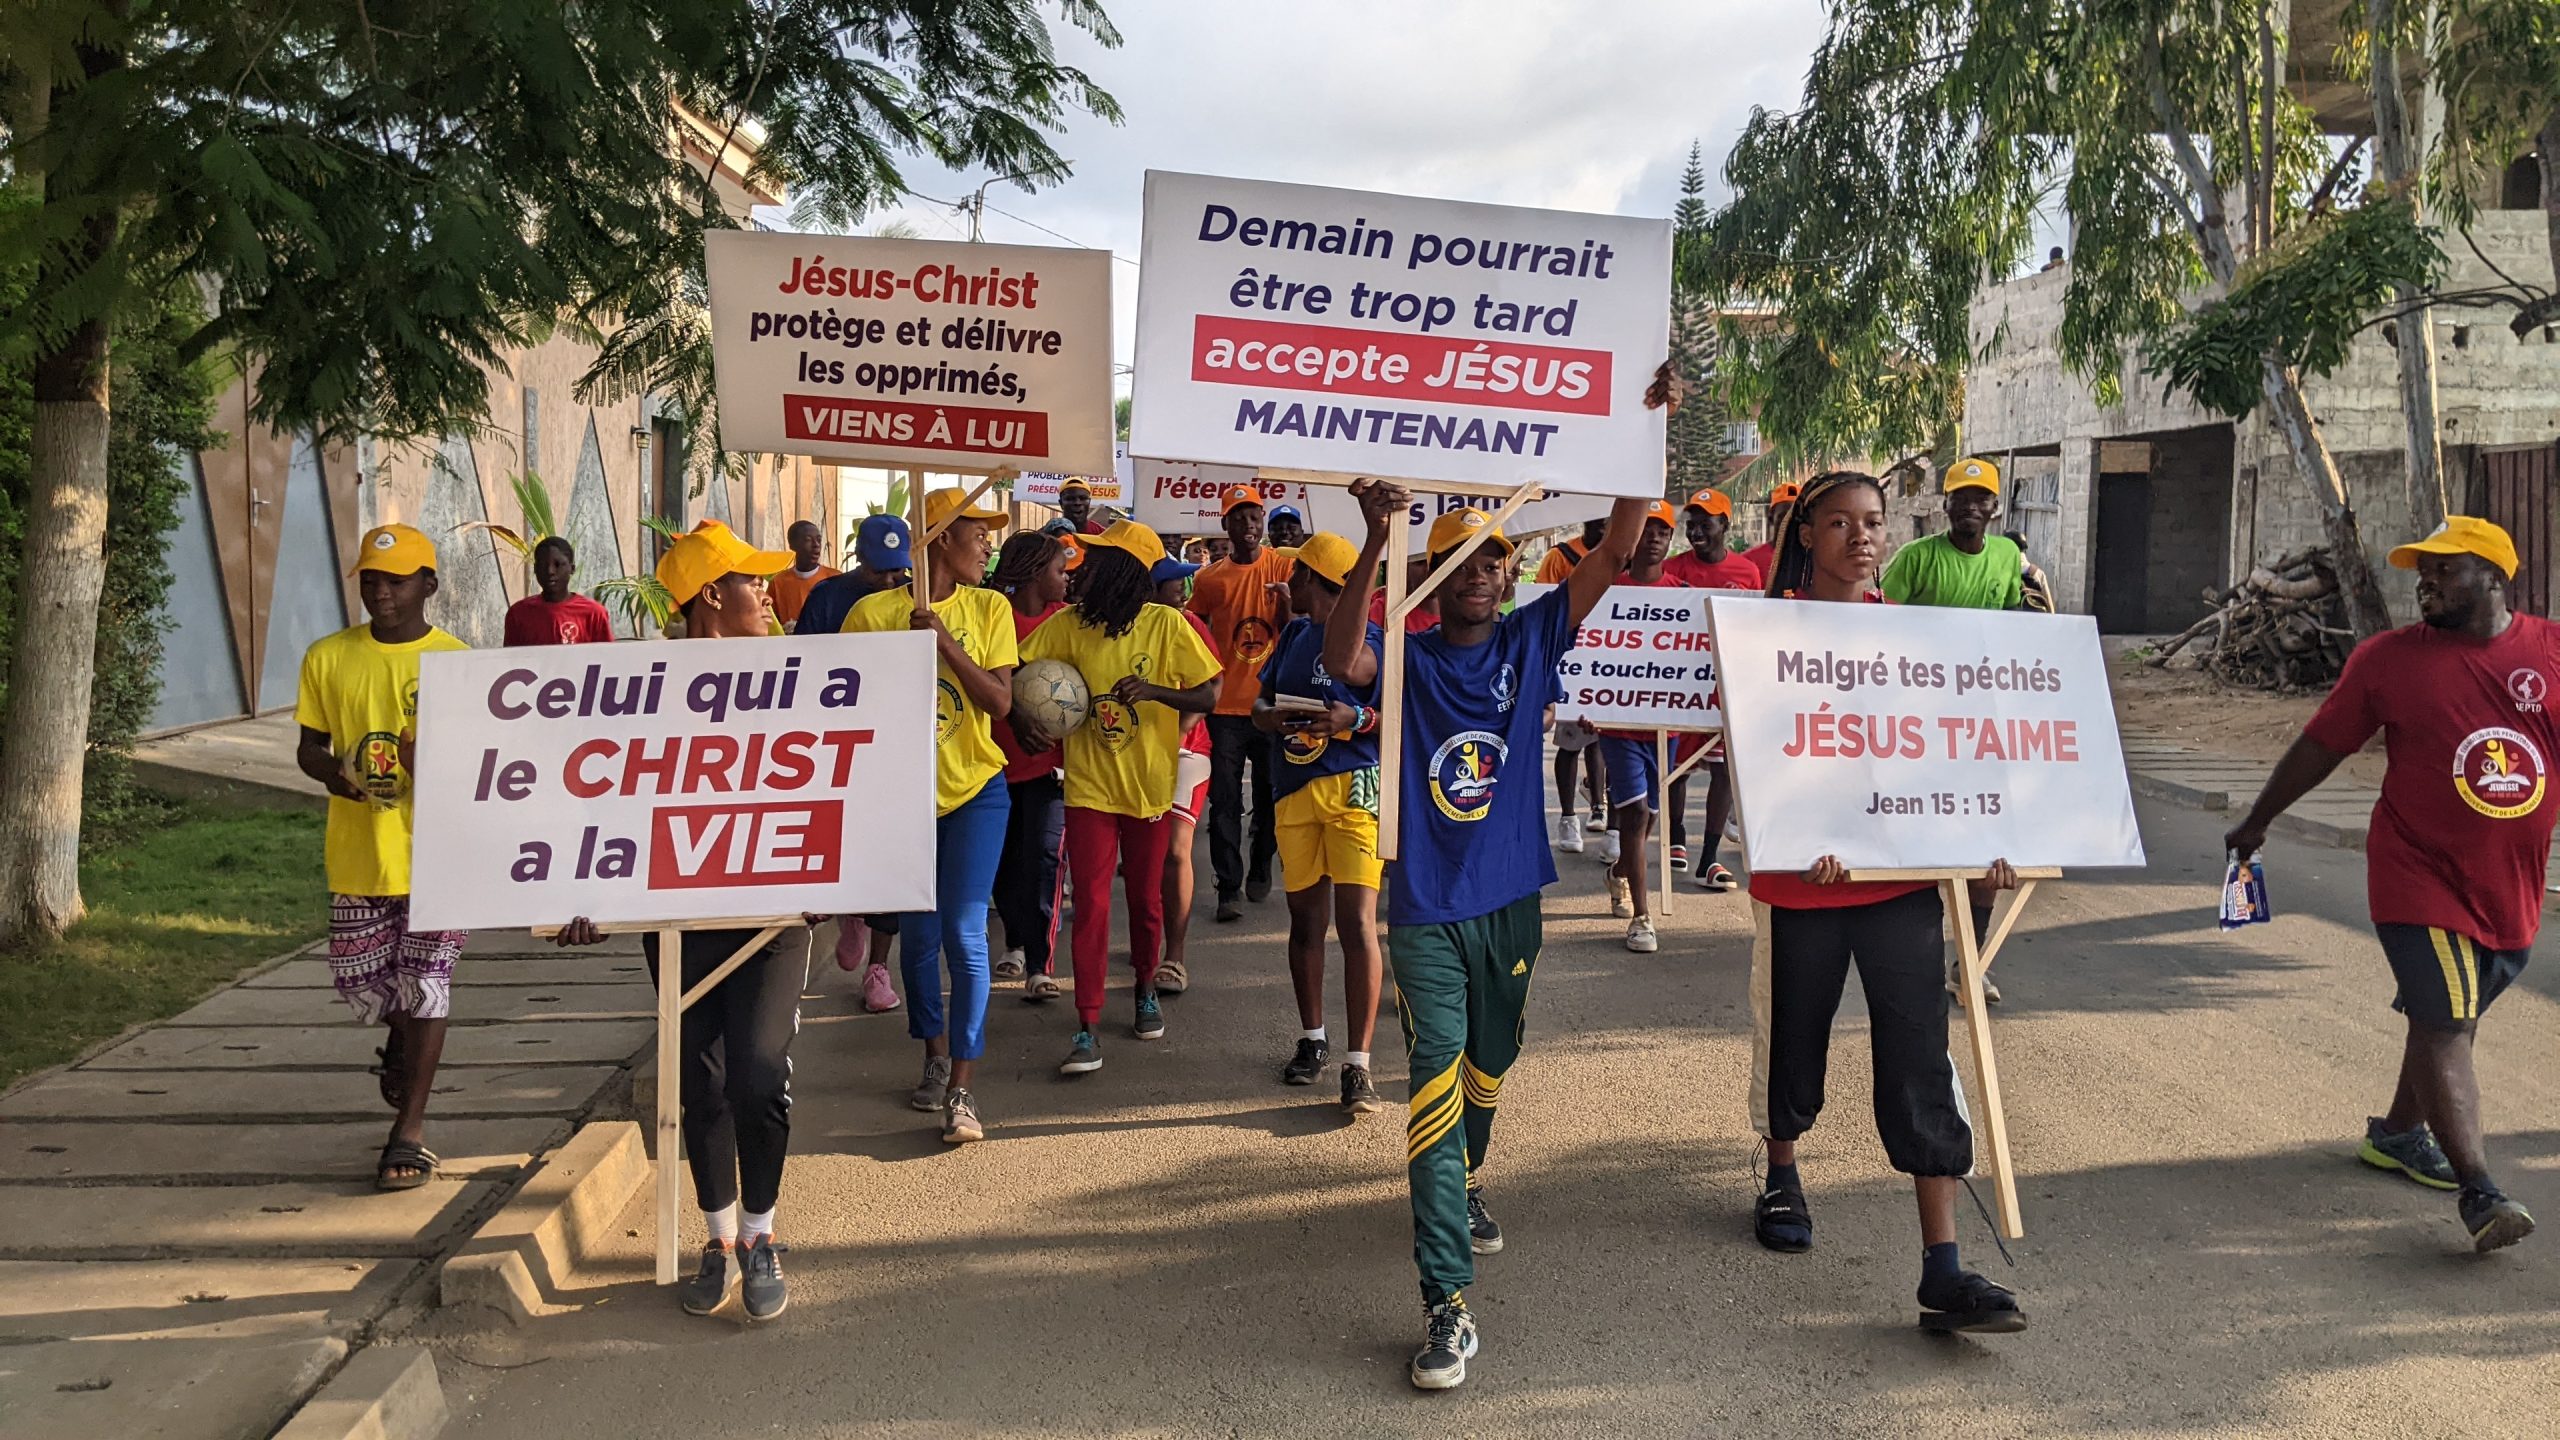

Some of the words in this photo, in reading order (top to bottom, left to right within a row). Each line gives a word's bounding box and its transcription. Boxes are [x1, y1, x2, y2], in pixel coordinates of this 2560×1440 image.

[1199, 203, 1394, 259] Demain
[1407, 233, 1614, 280] pourrait
[779, 255, 1039, 309] Jésus-Christ
[1229, 267, 1332, 315] être
[1351, 281, 1456, 332] trop
[1473, 292, 1577, 337] tard
[750, 308, 885, 349] protège
[896, 317, 931, 347] et
[941, 317, 1062, 356] délivre
[798, 351, 845, 385] les
[855, 362, 1027, 404] opprimés,
[1204, 337, 1410, 386] accepte
[1424, 343, 1593, 399] JÉSUS
[802, 406, 915, 441] VIENS
[924, 409, 953, 445] À
[965, 418, 1026, 449] LUI
[1233, 398, 1558, 457] MAINTENANT
[1027, 484, 1060, 494] PRÉSEN
[1611, 603, 1691, 622] Laisse
[1574, 624, 1644, 649] ÉSUS
[1652, 631, 1713, 652] CHR
[487, 662, 667, 721] Celui
[686, 657, 801, 723] qui
[819, 667, 861, 708] a
[1311, 677, 1332, 687] EEPTO
[1558, 659, 1582, 676] te
[1591, 660, 1687, 681] toucher
[1776, 650, 1889, 692] Malgré
[1898, 656, 1946, 688] tes
[1955, 656, 2061, 695] péchés
[1497, 698, 1516, 713] EEPT
[1577, 688, 1721, 710] SOUFFRAN
[1782, 701, 1925, 760] JÉSUS
[1938, 716, 2080, 762] T'AIME
[474, 748, 537, 801] le
[562, 729, 875, 798] CHRIST
[1865, 791, 1923, 816] Jean
[1931, 793, 1956, 815] 15
[1963, 797, 1969, 815] :
[1977, 793, 2001, 815] 13
[510, 841, 552, 883] a
[574, 826, 637, 880] la
[667, 810, 825, 877] VIE.
